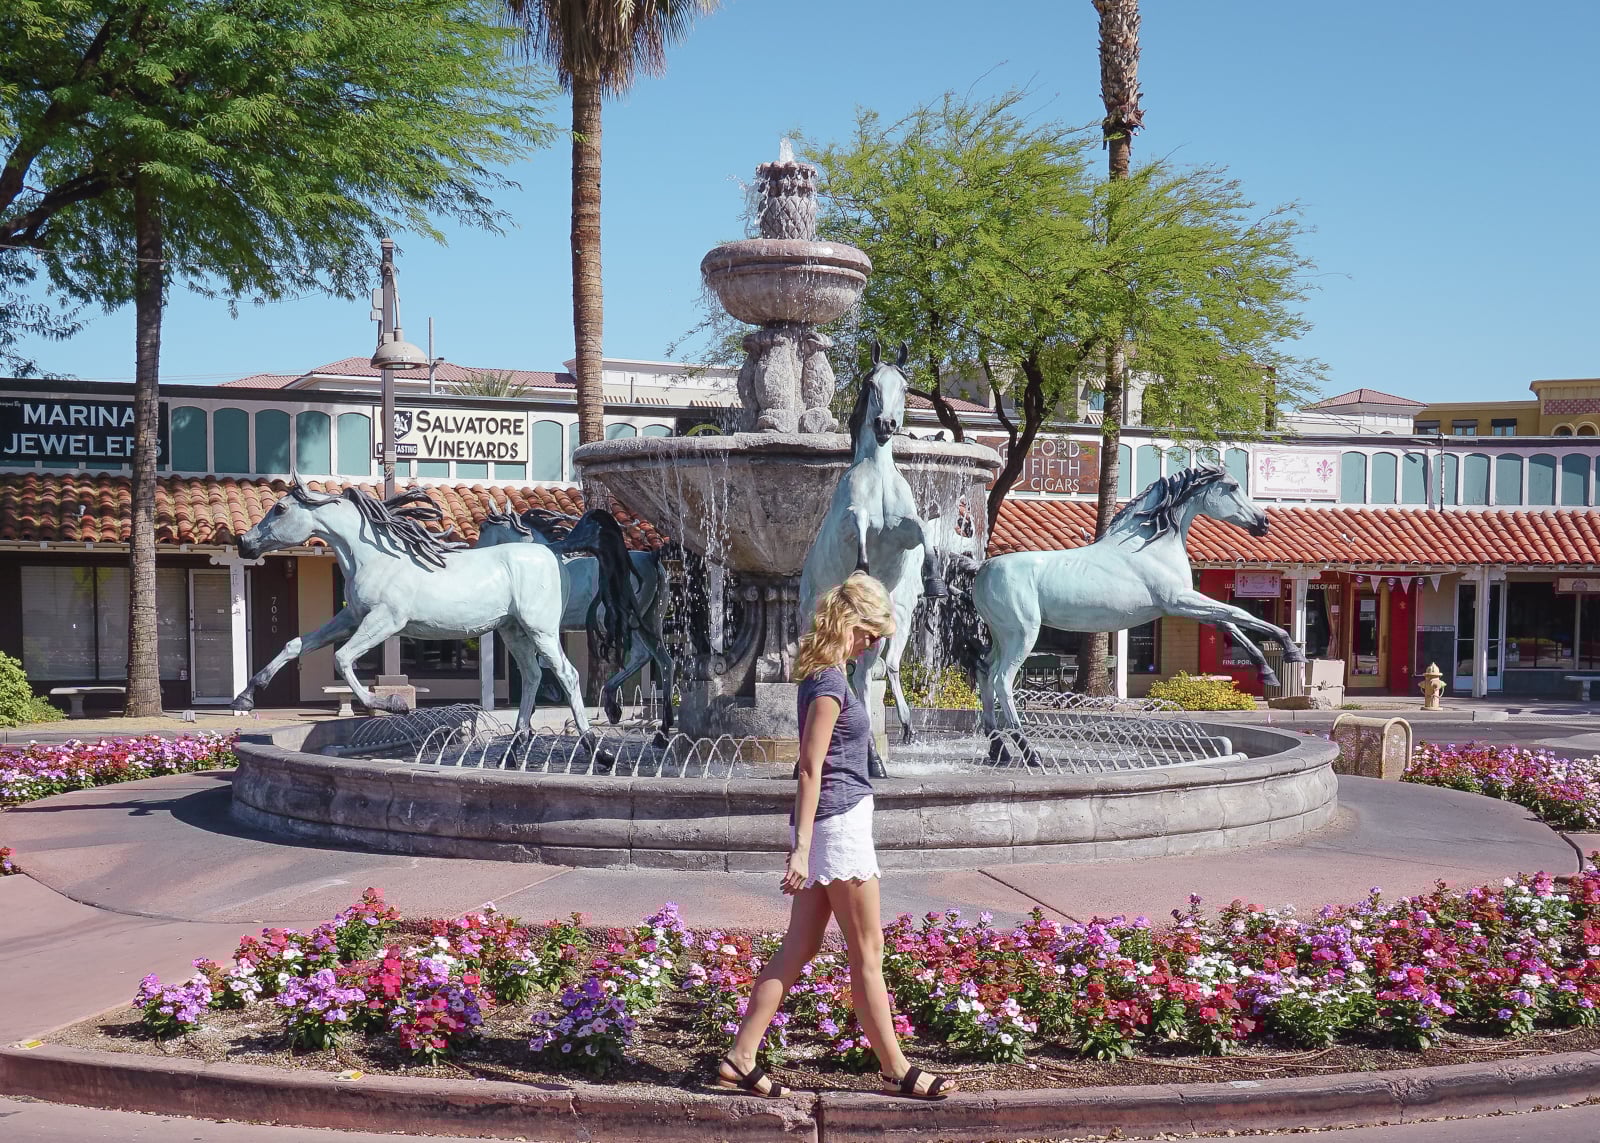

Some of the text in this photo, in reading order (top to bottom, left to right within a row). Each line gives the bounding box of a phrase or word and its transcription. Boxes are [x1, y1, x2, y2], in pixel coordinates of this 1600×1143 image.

[24, 404, 135, 427] MARINA
[416, 410, 524, 435] SALVATORE
[423, 435, 518, 459] VINEYARDS
[1031, 440, 1080, 458] FORD
[1031, 459, 1080, 476] FIFTH
[1031, 478, 1080, 492] CIGARS
